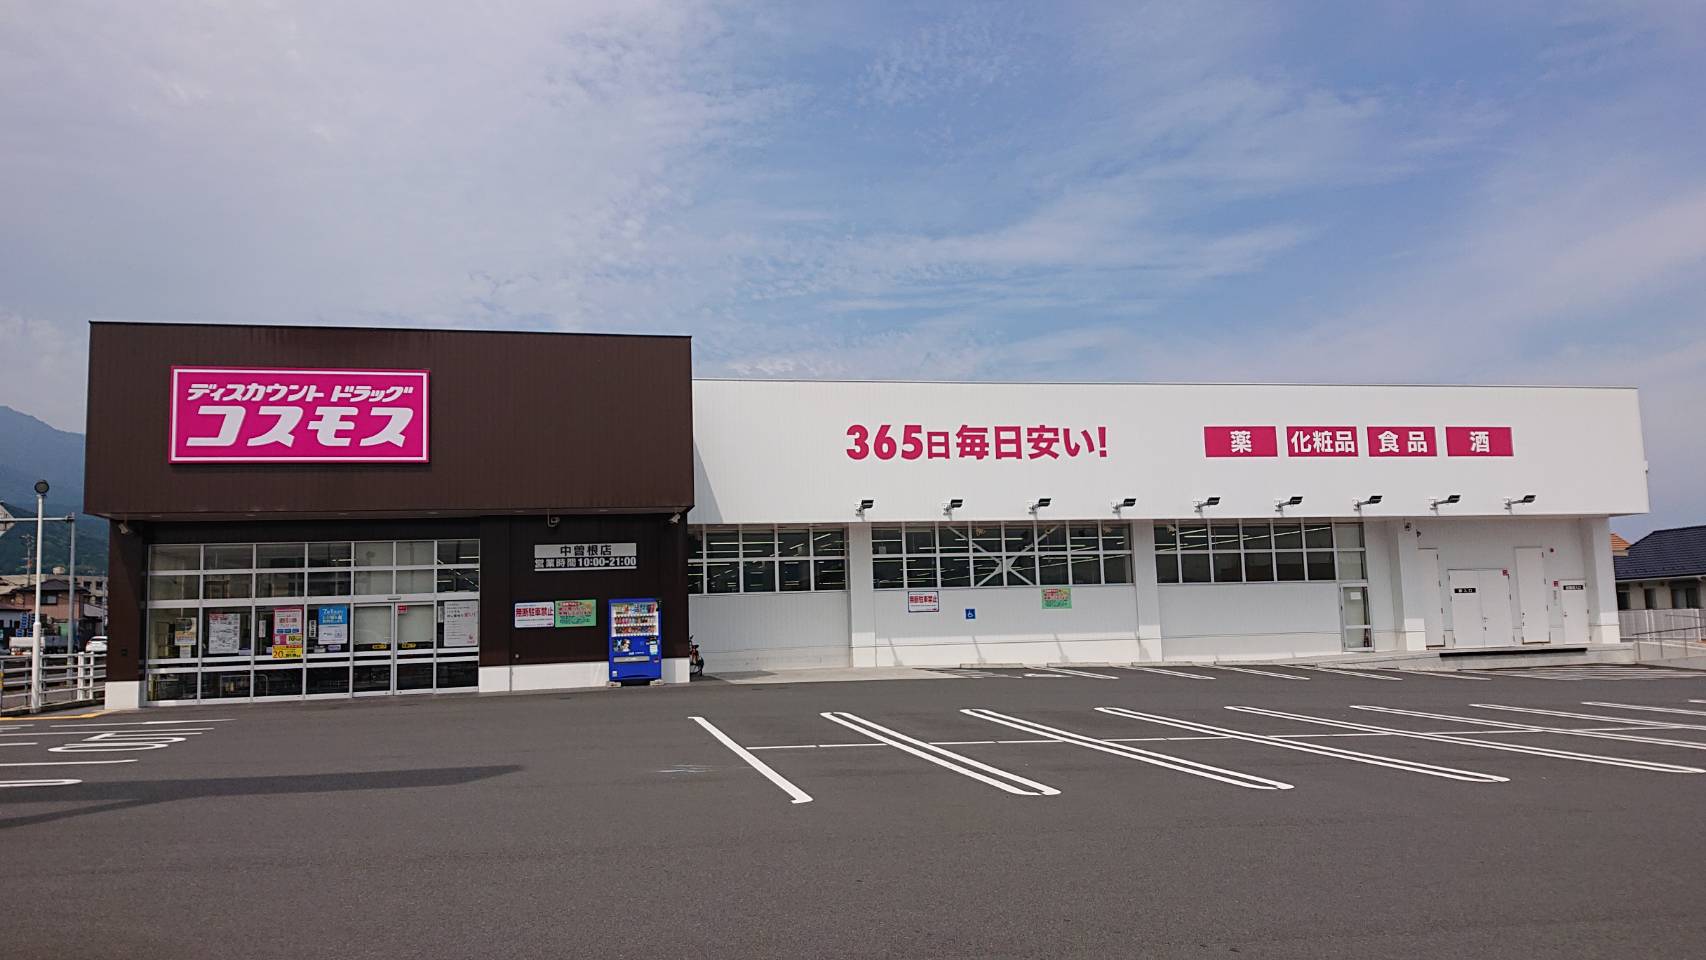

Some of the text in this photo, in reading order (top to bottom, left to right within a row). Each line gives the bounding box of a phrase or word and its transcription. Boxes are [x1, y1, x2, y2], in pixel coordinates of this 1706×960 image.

[187, 382, 414, 402] ディスカウント ドラッグ
[186, 405, 414, 448] コスモス
[1230, 431, 1253, 453] 薬
[1291, 431, 1356, 453] 化粧品
[1378, 431, 1428, 453] 食品
[1470, 431, 1491, 453] 酒
